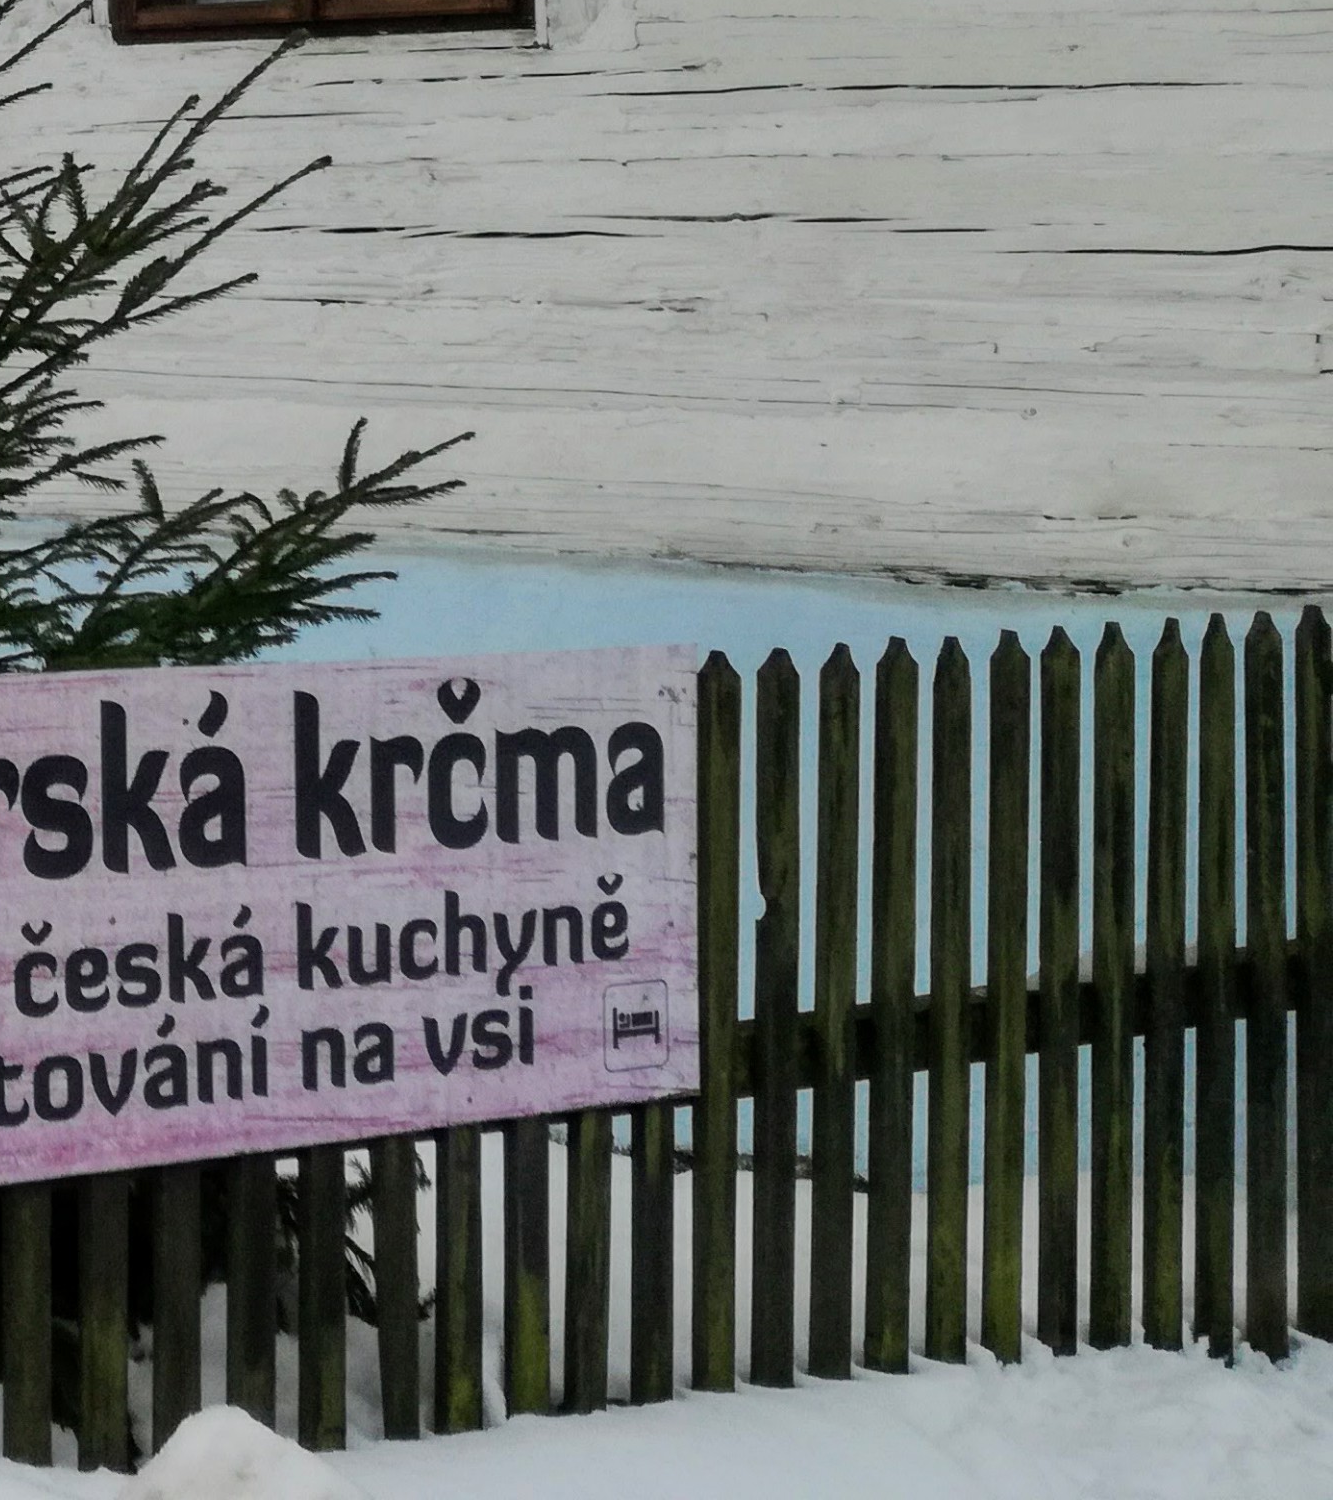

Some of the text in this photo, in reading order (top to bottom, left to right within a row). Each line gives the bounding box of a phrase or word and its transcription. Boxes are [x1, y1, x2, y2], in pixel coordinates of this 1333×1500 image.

[294, 678, 665, 860] krčma
[14, 905, 264, 1018] česká
[296, 873, 630, 997] kuchyně
[302, 1022, 395, 1092] na
[422, 985, 535, 1076] vsi
